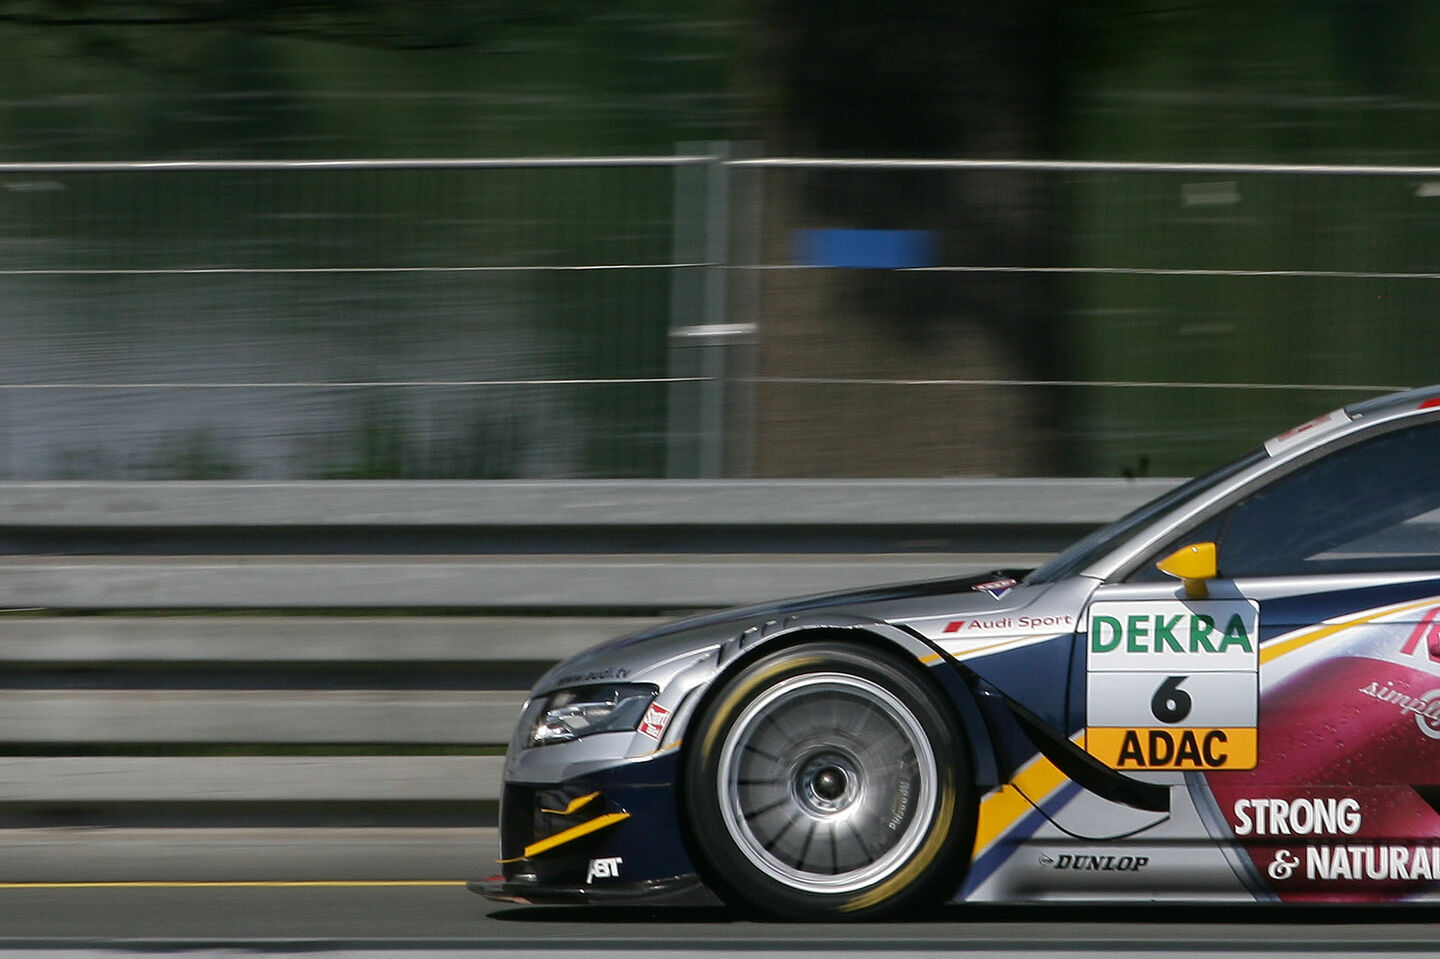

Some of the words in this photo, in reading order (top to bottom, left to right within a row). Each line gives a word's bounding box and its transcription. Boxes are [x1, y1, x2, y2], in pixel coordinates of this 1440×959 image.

[968, 617, 1012, 630] Audi
[1018, 614, 1074, 629] Sport
[1091, 613, 1254, 654] DEKRA
[1151, 675, 1192, 724] 6
[1117, 730, 1228, 767] ADAC
[1234, 798, 1362, 835] STRONG
[586, 856, 623, 884] ABT
[1053, 854, 1149, 871] DUNLOP
[1268, 849, 1300, 880] &
